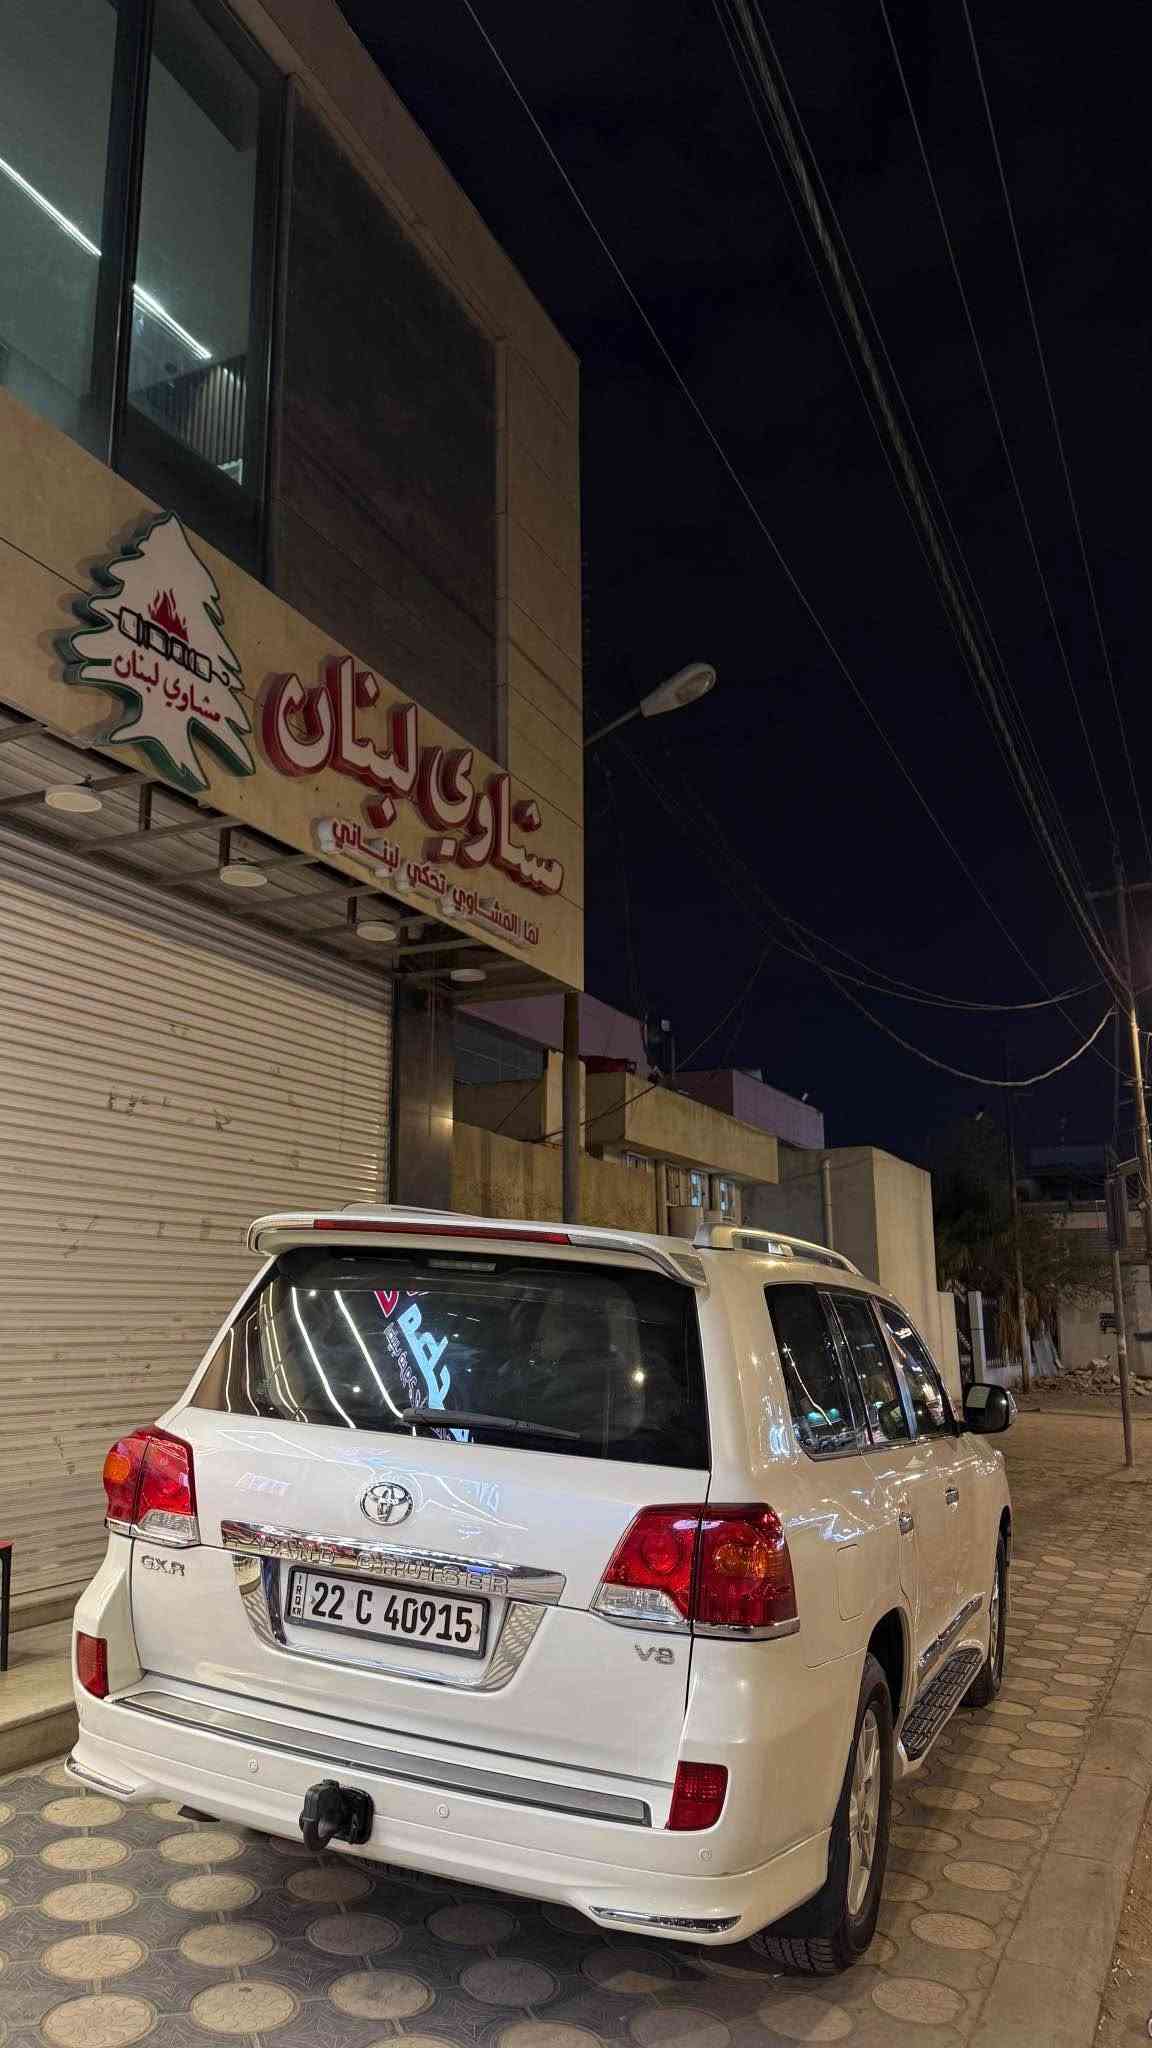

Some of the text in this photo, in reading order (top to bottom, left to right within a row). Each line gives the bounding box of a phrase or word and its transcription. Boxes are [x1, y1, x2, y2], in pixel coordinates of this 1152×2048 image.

[113, 649, 222, 722] مشاوي لبنان
[267, 656, 418, 830] لبنان
[141, 1555, 185, 1577] GXR
[356, 1553, 508, 1593] CRUISER
[311, 1582, 473, 1643] 22 C 40915
[634, 1644, 675, 1665] V8
